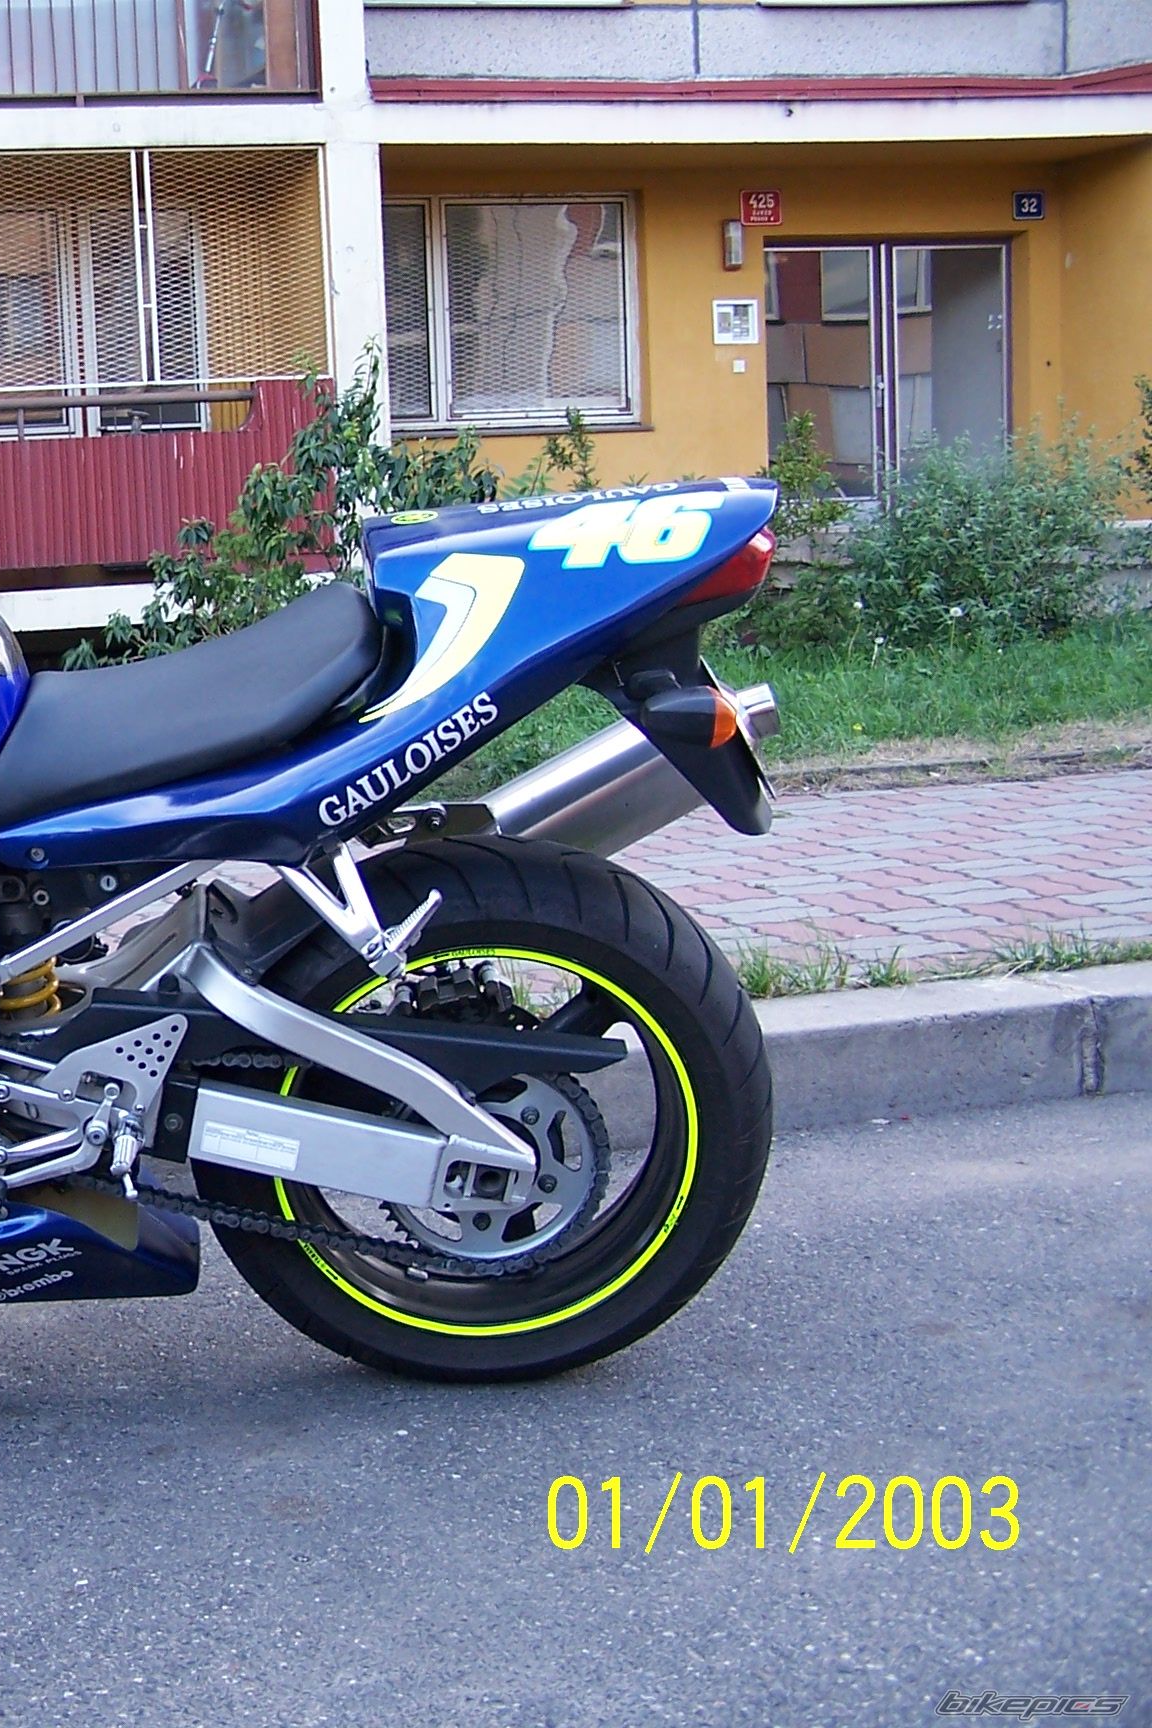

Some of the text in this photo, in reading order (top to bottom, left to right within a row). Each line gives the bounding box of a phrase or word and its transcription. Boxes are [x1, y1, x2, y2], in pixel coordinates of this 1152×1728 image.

[748, 193, 775, 209] 425
[1021, 198, 1038, 213] 32
[476, 482, 679, 514] GAULOISES
[527, 491, 726, 569] 46
[318, 691, 498, 826] GAULOISES
[1, 1270, 74, 1297] brembo
